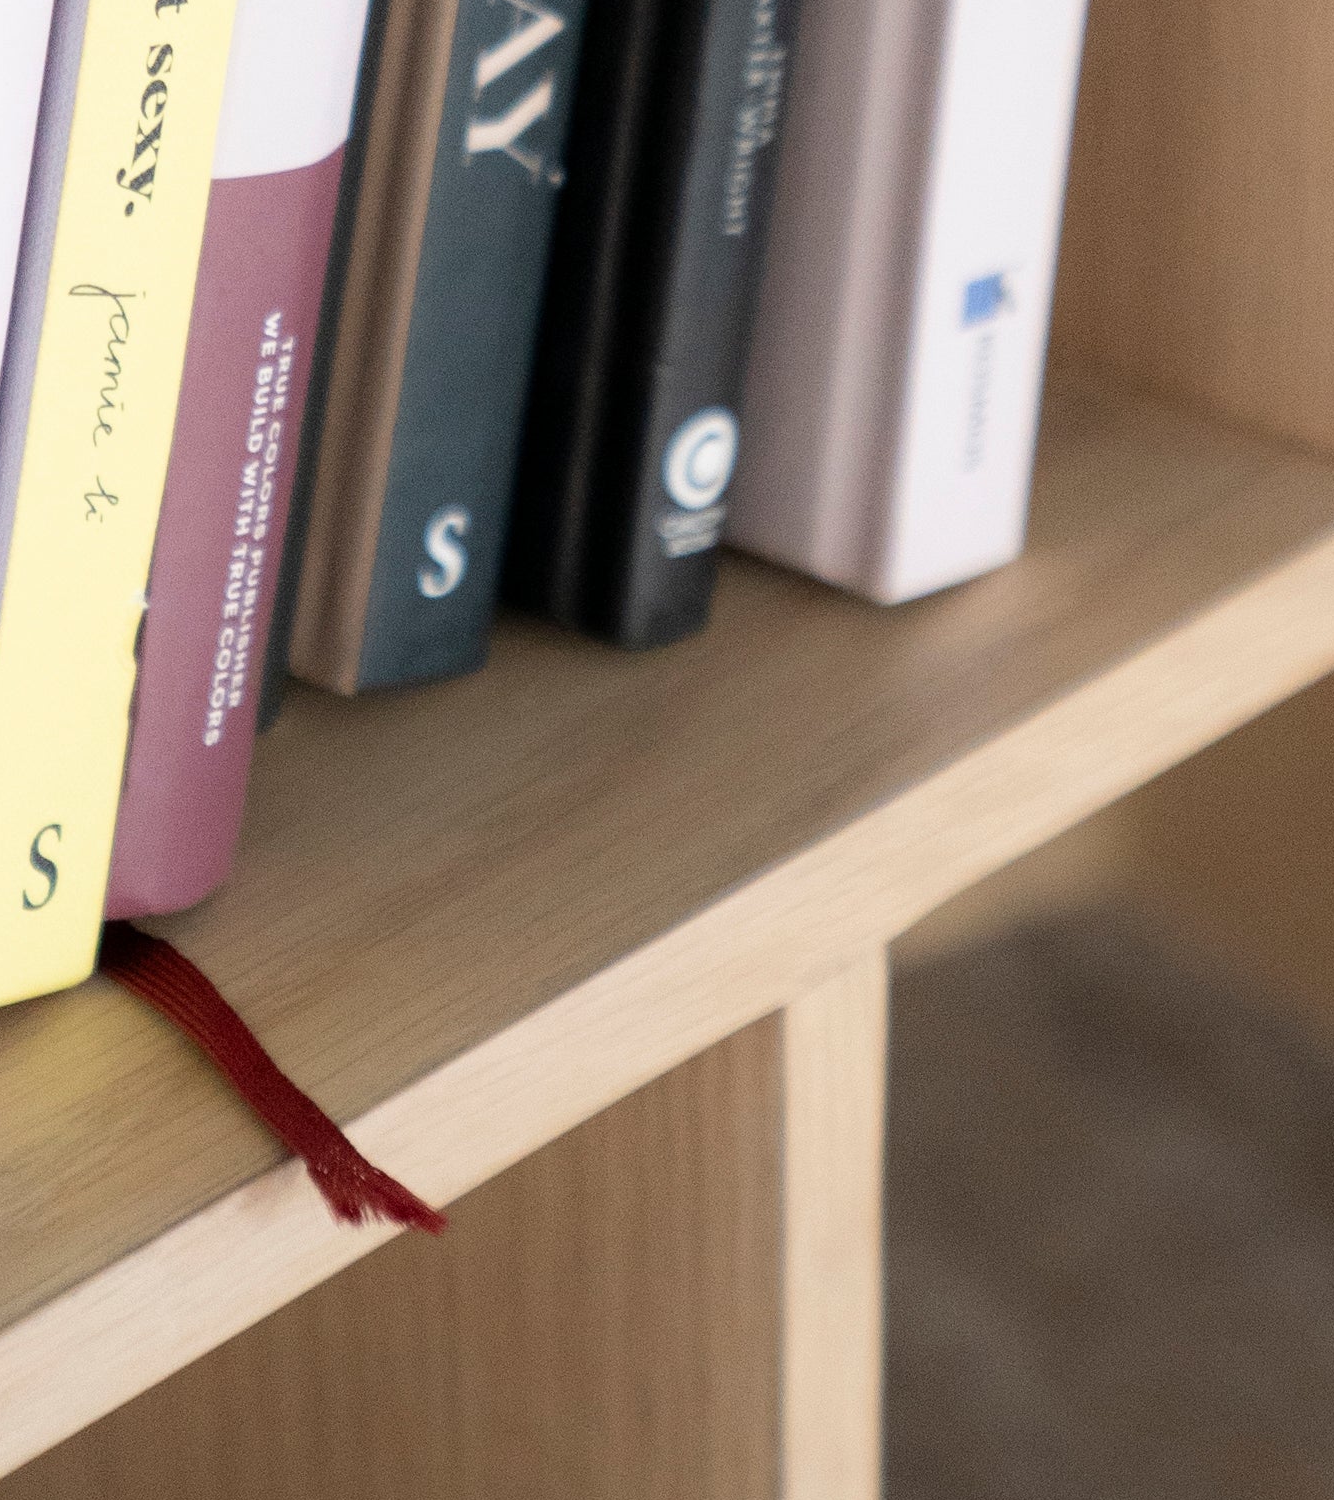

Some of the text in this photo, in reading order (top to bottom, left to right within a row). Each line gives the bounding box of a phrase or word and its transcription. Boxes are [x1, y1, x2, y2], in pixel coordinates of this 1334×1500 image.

[115, 41, 176, 219] sexy.
[202, 311, 283, 749] WE BUILD WITH TRUE COLORS
[227, 336, 295, 709] TRUE COLORS PUBLISHER
[417, 504, 469, 601] S
[19, 822, 65, 912] S
